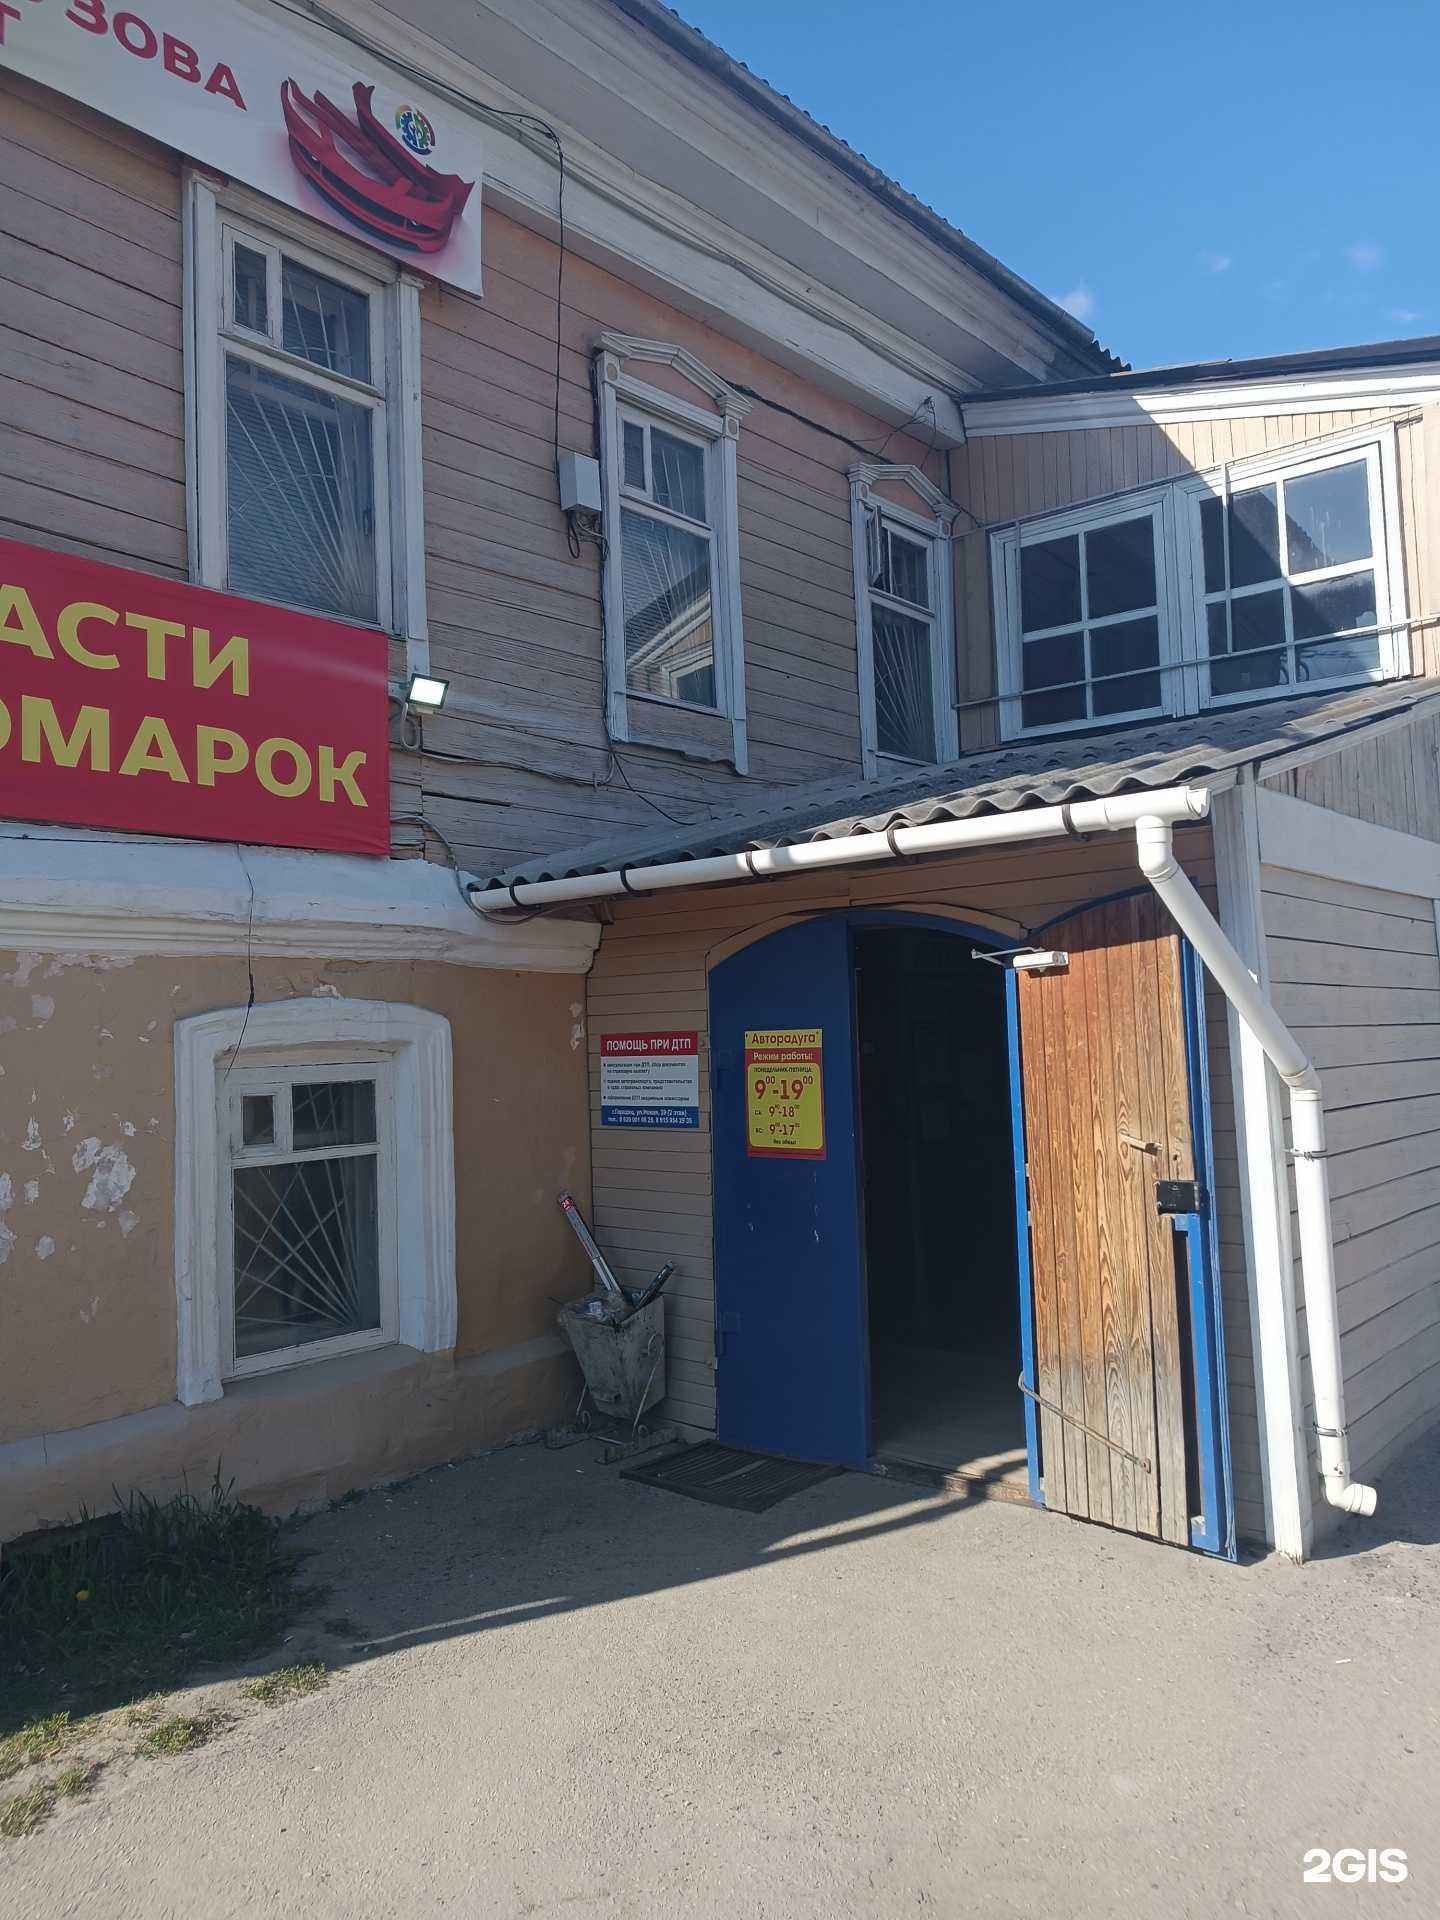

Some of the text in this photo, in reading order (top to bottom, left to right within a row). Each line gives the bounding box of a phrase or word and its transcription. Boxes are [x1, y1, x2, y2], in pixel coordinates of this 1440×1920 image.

[0, 694, 369, 808] МАРОК
[606, 1038, 691, 1052] ПОМОЩЬ ПРИ ДТП
[751, 1032, 816, 1047] Авторадуга
[753, 1052, 779, 1061] Режим
